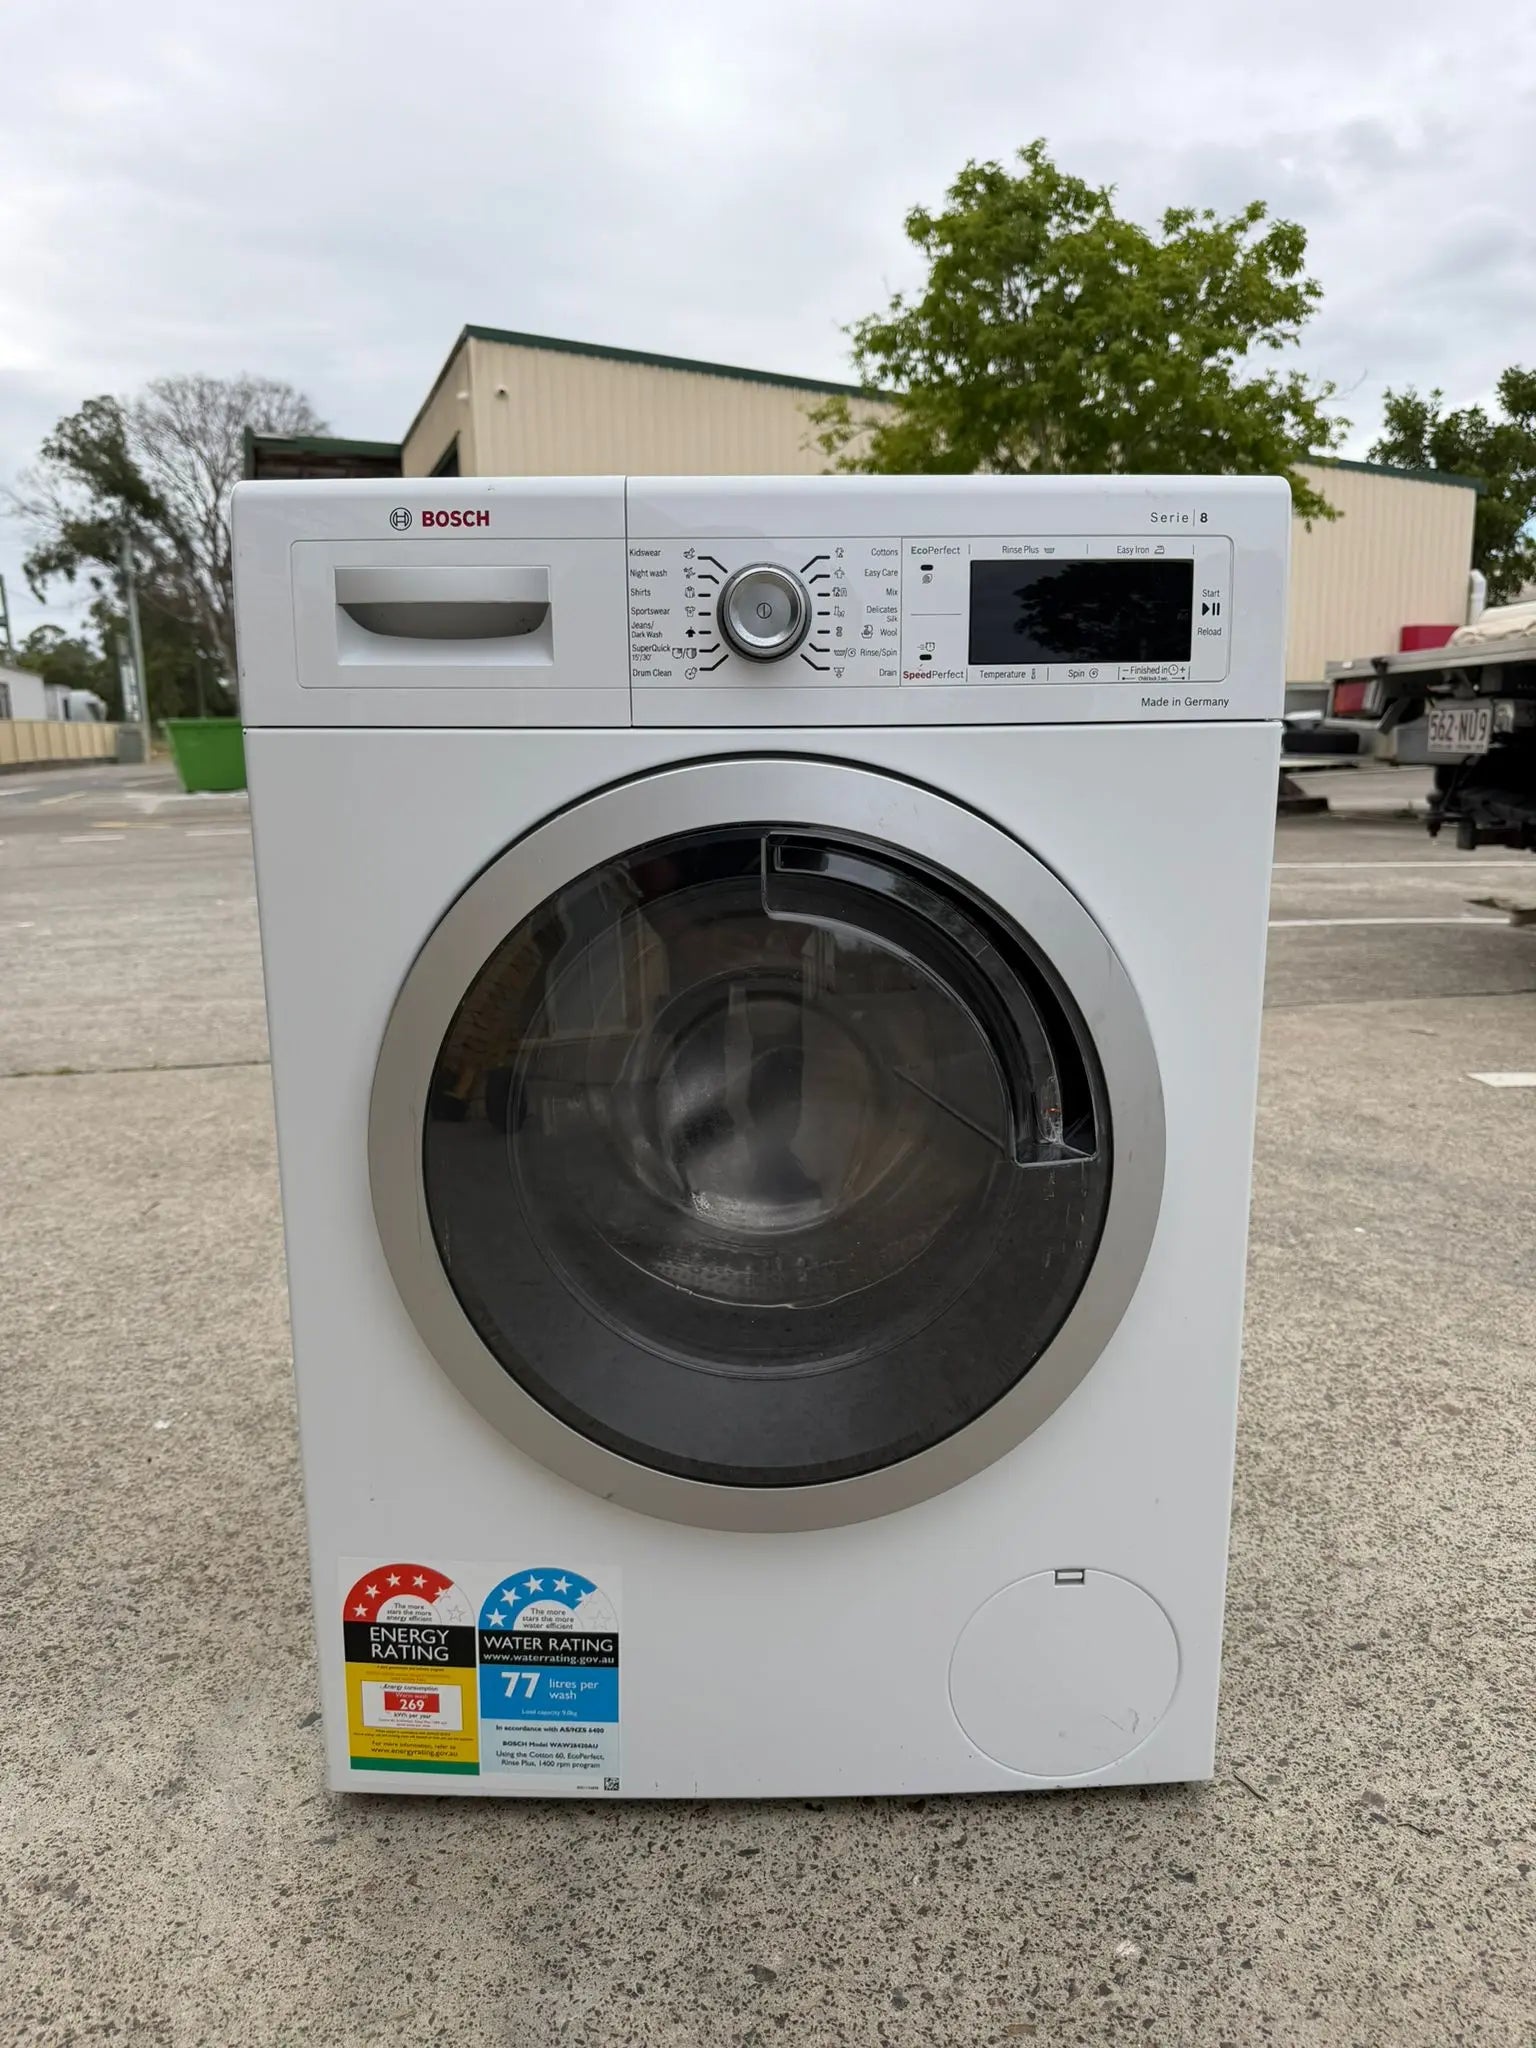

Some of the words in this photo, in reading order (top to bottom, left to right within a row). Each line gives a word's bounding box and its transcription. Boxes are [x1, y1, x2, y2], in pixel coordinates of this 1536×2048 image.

[422, 510, 490, 527] BOSCH
[1150, 512, 1189, 523] Serie
[1200, 513, 1208, 523] 8
[629, 548, 661, 557] Kidswear
[871, 548, 898, 556] Cottons
[911, 546, 960, 555] EcoPerfect
[1002, 546, 1021, 554] Rinse
[1023, 546, 1039, 554] Plus
[1117, 546, 1133, 556] Easy
[1134, 546, 1150, 554] Iron
[630, 569, 648, 579] Night
[650, 569, 668, 577] wash
[864, 569, 880, 578] Easy
[882, 569, 898, 577] Care
[630, 588, 651, 597] Shirts
[886, 588, 898, 596] Mix
[1202, 589, 1220, 598] Start
[631, 607, 670, 616] Sportswear
[866, 605, 898, 613] Delicates
[631, 621, 655, 630] Jeans/
[880, 629, 897, 637] Wool
[1197, 627, 1222, 636] Reload
[632, 644, 670, 652] SuperQuick
[860, 649, 897, 658] Rinse/Spin
[632, 669, 651, 677] Drum
[652, 669, 672, 677] Clean
[880, 669, 897, 677] Drain
[903, 670, 964, 679] SpeedPerfect
[980, 669, 1026, 679] Temperature
[1067, 669, 1085, 679] Spin
[1130, 666, 1160, 674] Finished
[1161, 666, 1168, 674] in
[1141, 697, 1169, 707] Made
[1171, 697, 1181, 706] in
[1184, 697, 1229, 709] Germany
[545, 1622, 573, 1630] efficient
[370, 1627, 449, 1644] ENERGY
[484, 1636, 543, 1650] WATER
[549, 1638, 613, 1652] RATING
[372, 1643, 449, 1660] RATING
[483, 1653, 615, 1665] www.waterrating.gov.au
[383, 1683, 404, 1691] Energy
[501, 1672, 540, 1699] 77
[549, 1678, 577, 1689] litres
[580, 1681, 599, 1691] per
[549, 1690, 577, 1700] wash
[400, 1699, 425, 1710] 269
[504, 1725, 542, 1733] accordance
[371, 1747, 458, 1757] www.energyrating.gov.au
[529, 1751, 553, 1759] Cotton
